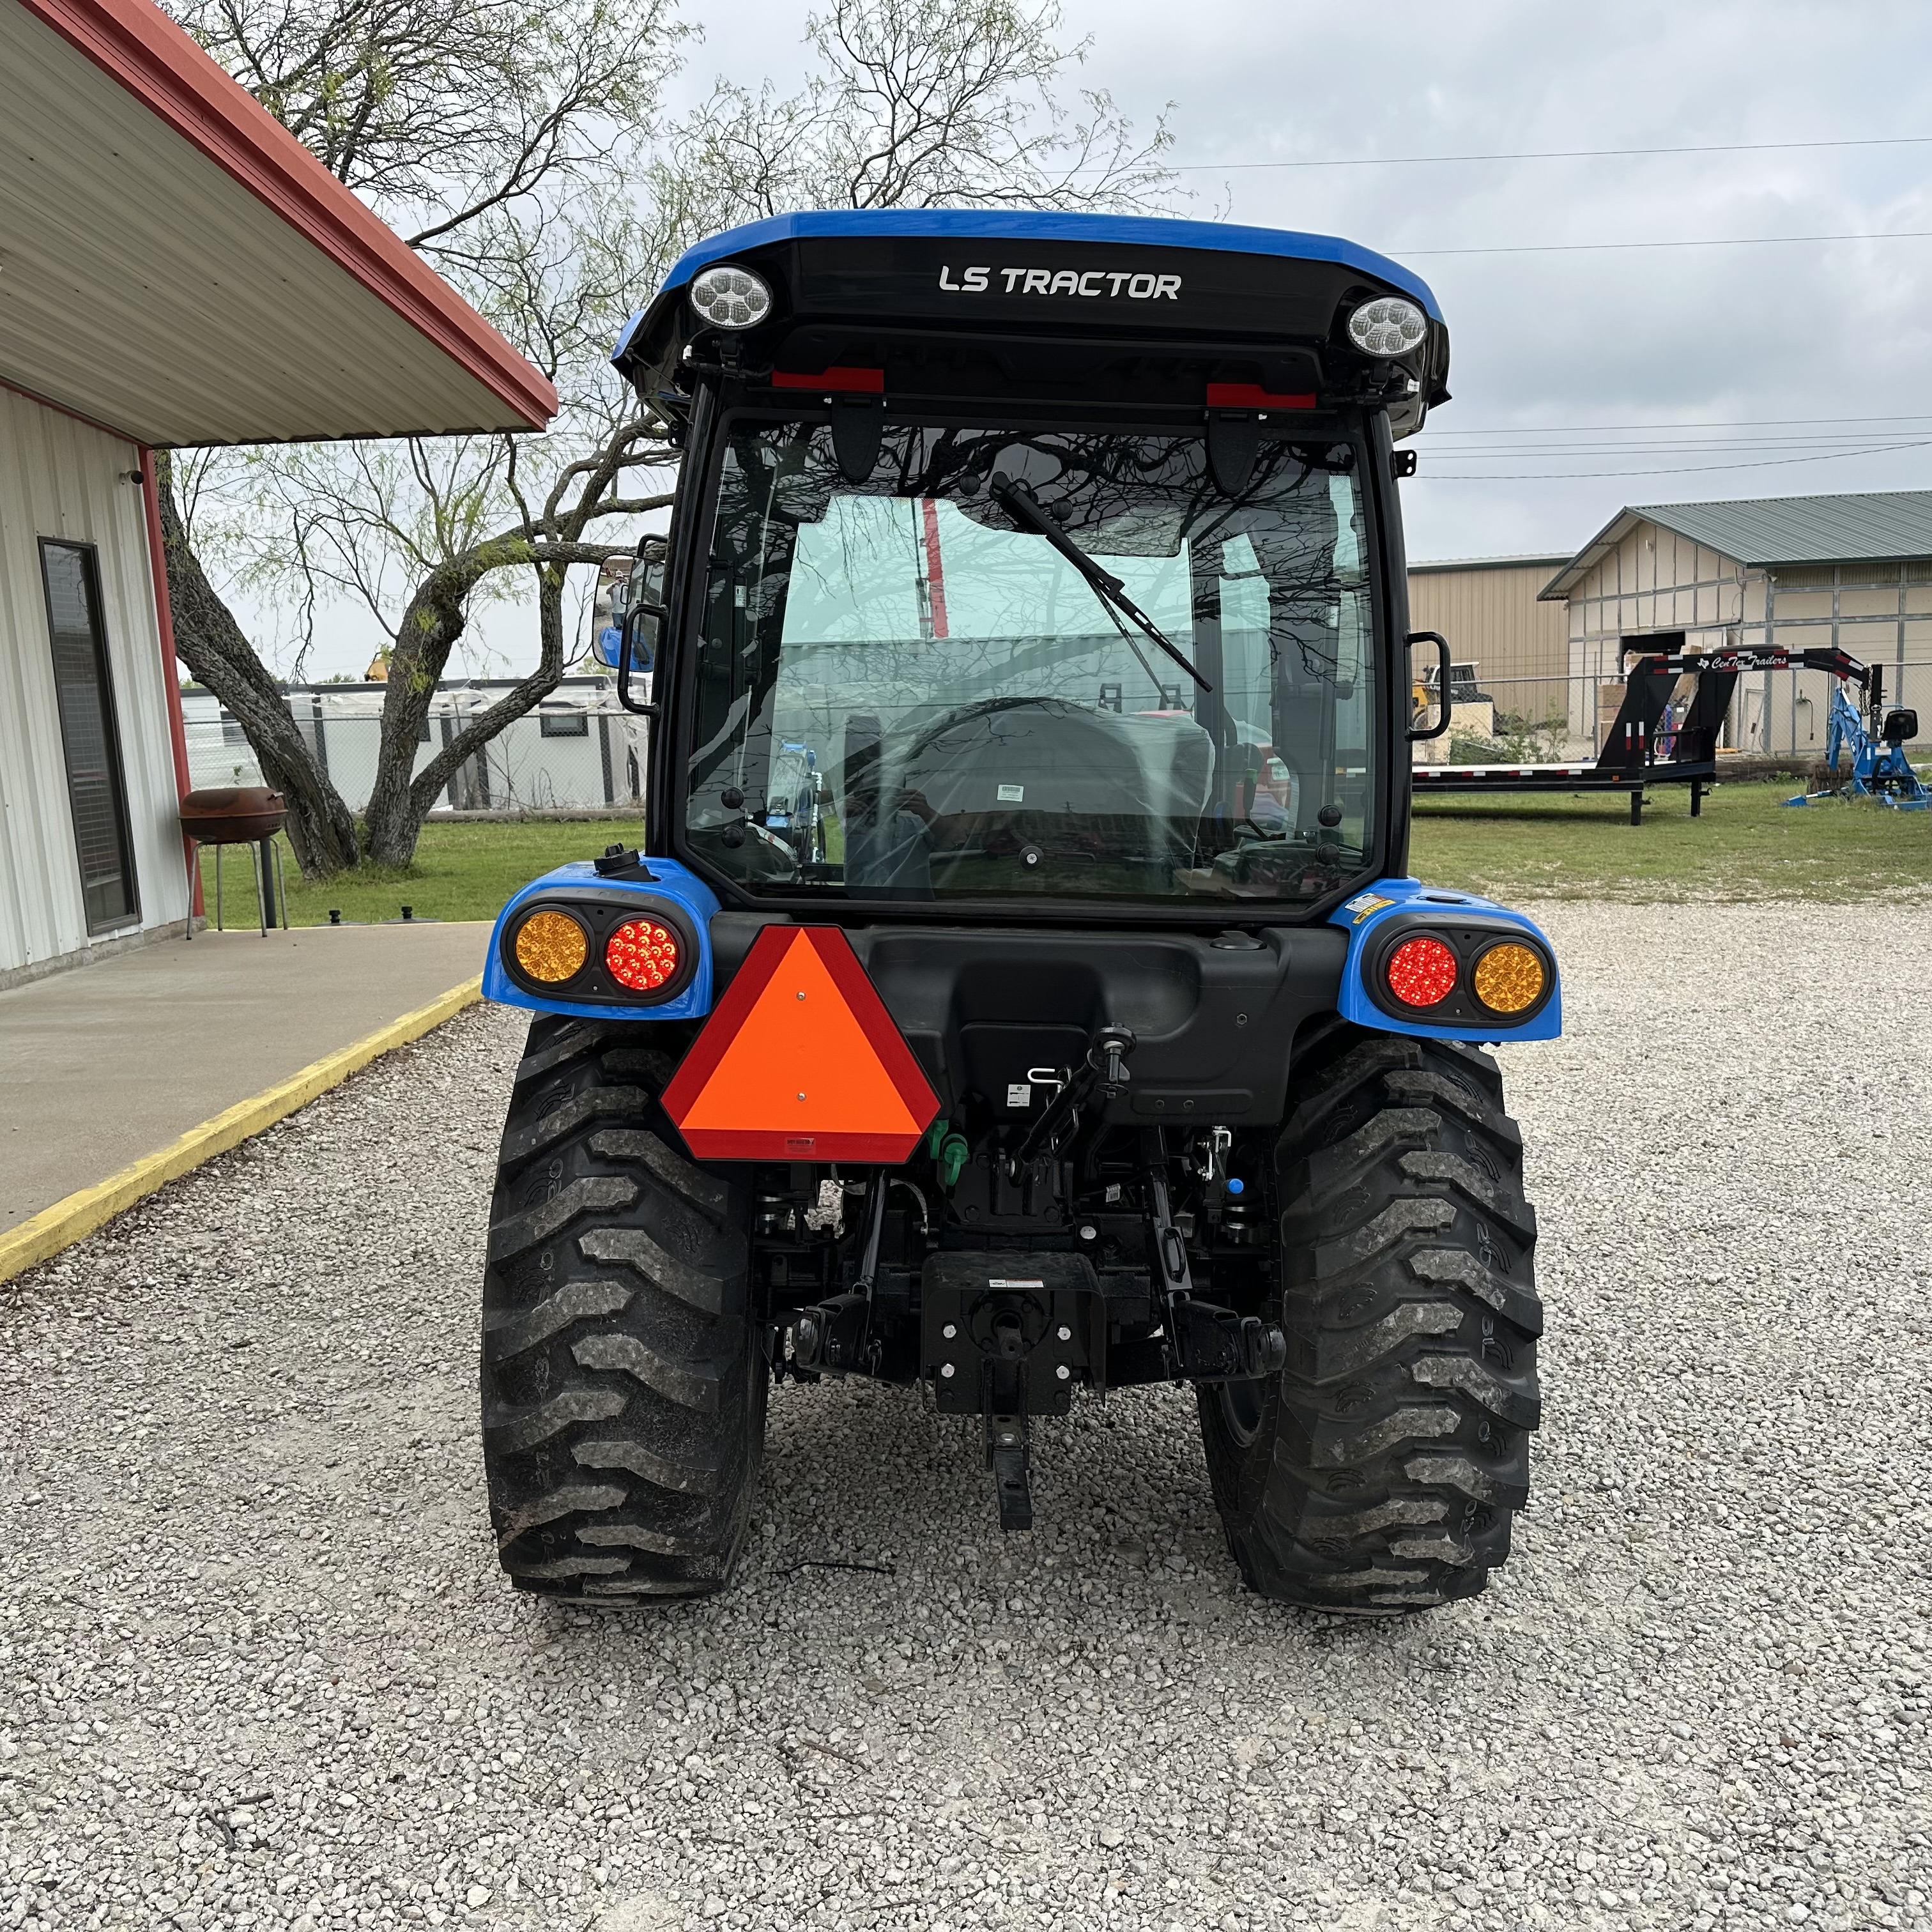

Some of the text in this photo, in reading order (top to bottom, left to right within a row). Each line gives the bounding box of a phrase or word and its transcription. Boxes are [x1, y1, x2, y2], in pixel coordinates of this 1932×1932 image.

[939, 265, 1181, 300] LS TRACTOR
[1748, 655, 1787, 666] Trailers
